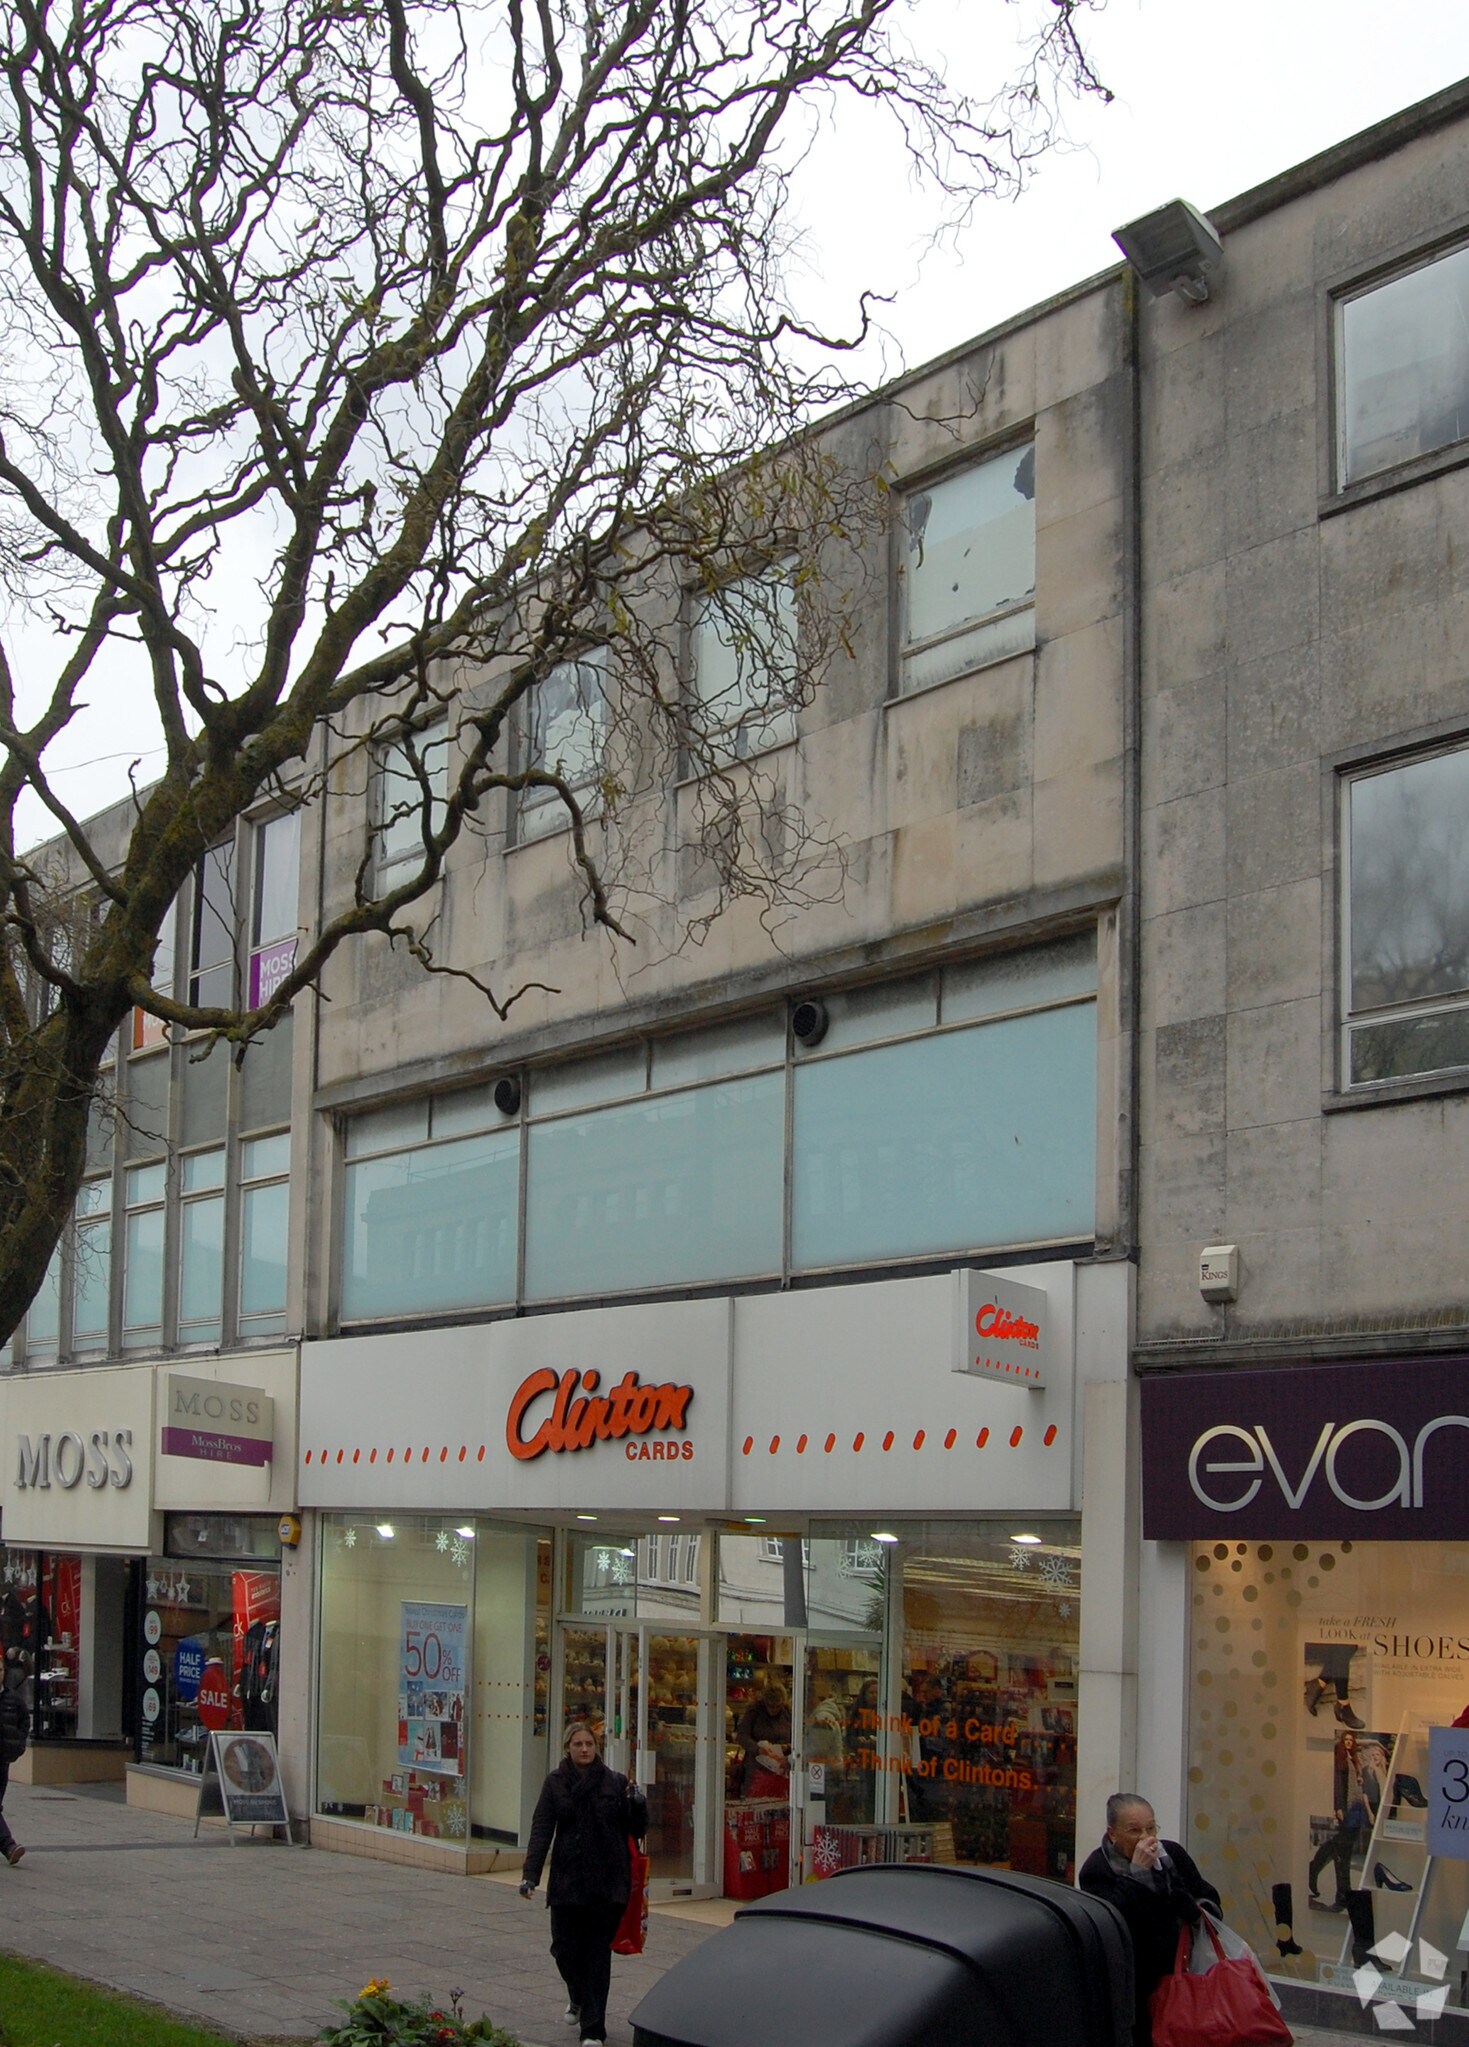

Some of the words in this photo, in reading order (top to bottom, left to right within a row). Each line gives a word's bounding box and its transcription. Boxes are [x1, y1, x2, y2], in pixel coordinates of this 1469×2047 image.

[260, 973, 290, 998] HIR
[975, 1303, 1039, 1341] Clinton
[174, 1390, 259, 1424] MOSS
[505, 1366, 695, 1461] Clinton
[13, 1428, 133, 1489] MOSS
[200, 1448, 233, 1460] HIRE
[625, 1440, 695, 1461] CARDS
[1353, 1616, 1397, 1628] FRESH
[1319, 1628, 1357, 1640] LOOK
[1374, 1634, 1469, 1661] SHOES
[179, 1651, 201, 1666] HALF
[178, 1665, 201, 1679] PRICE
[442, 1666, 462, 1682] OFF
[200, 1689, 228, 1708] SALE
[918, 1714, 940, 1736] of
[945, 1721, 957, 1739] a
[916, 1757, 938, 1777] of
